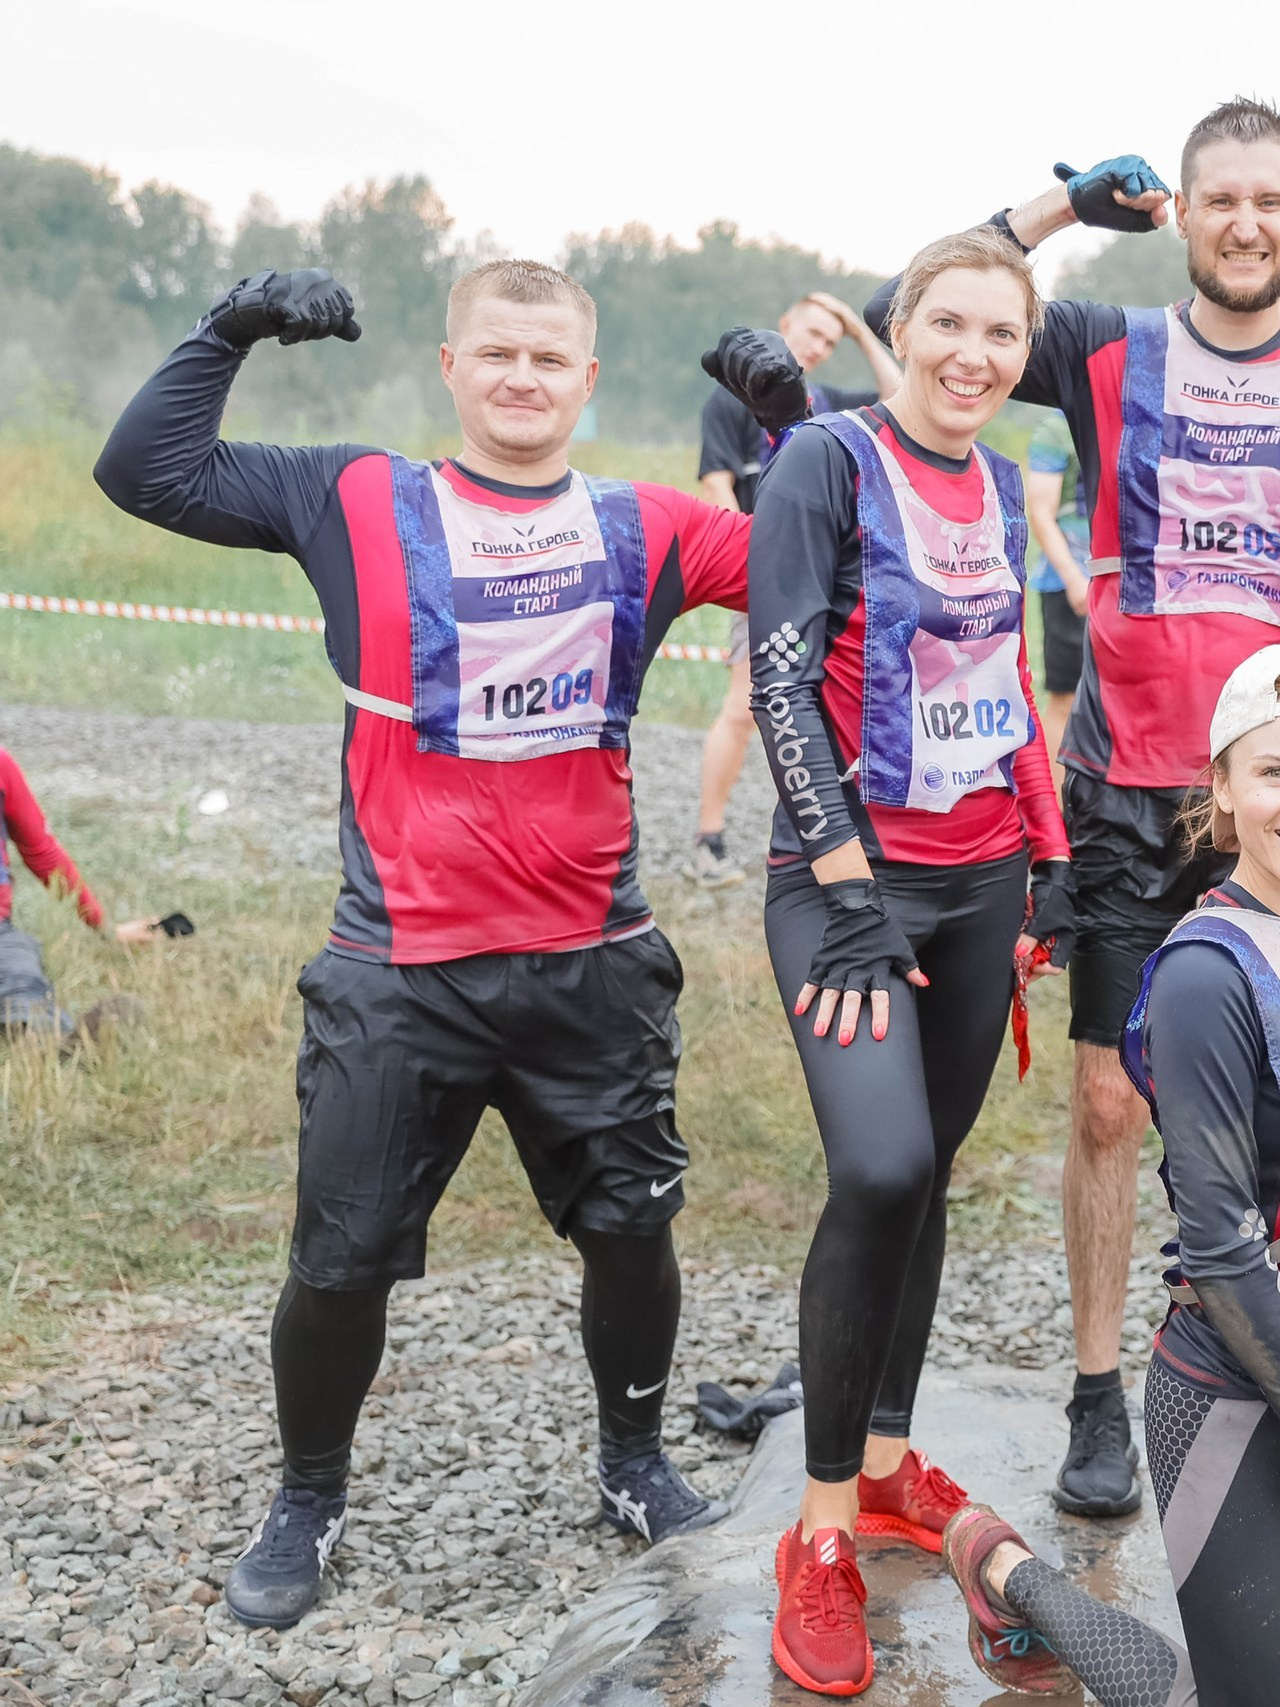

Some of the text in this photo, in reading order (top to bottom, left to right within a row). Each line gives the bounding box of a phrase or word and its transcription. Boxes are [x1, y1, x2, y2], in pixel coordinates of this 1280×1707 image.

[1184, 382, 1229, 402] ГОНКА
[1209, 446, 1254, 463] СТАРТ
[472, 530, 580, 555] ГОНКА ГЕРОЕВ
[923, 553, 957, 574] ГОНКА
[960, 556, 1002, 574] ГЕРОЕВ
[483, 565, 583, 598] КОМАНДНЫЙ
[513, 593, 560, 615] СТАРТ
[942, 589, 1010, 616] КОМАНДНЫЙ
[959, 617, 994, 637] СТАРТ
[482, 668, 595, 721] 10209
